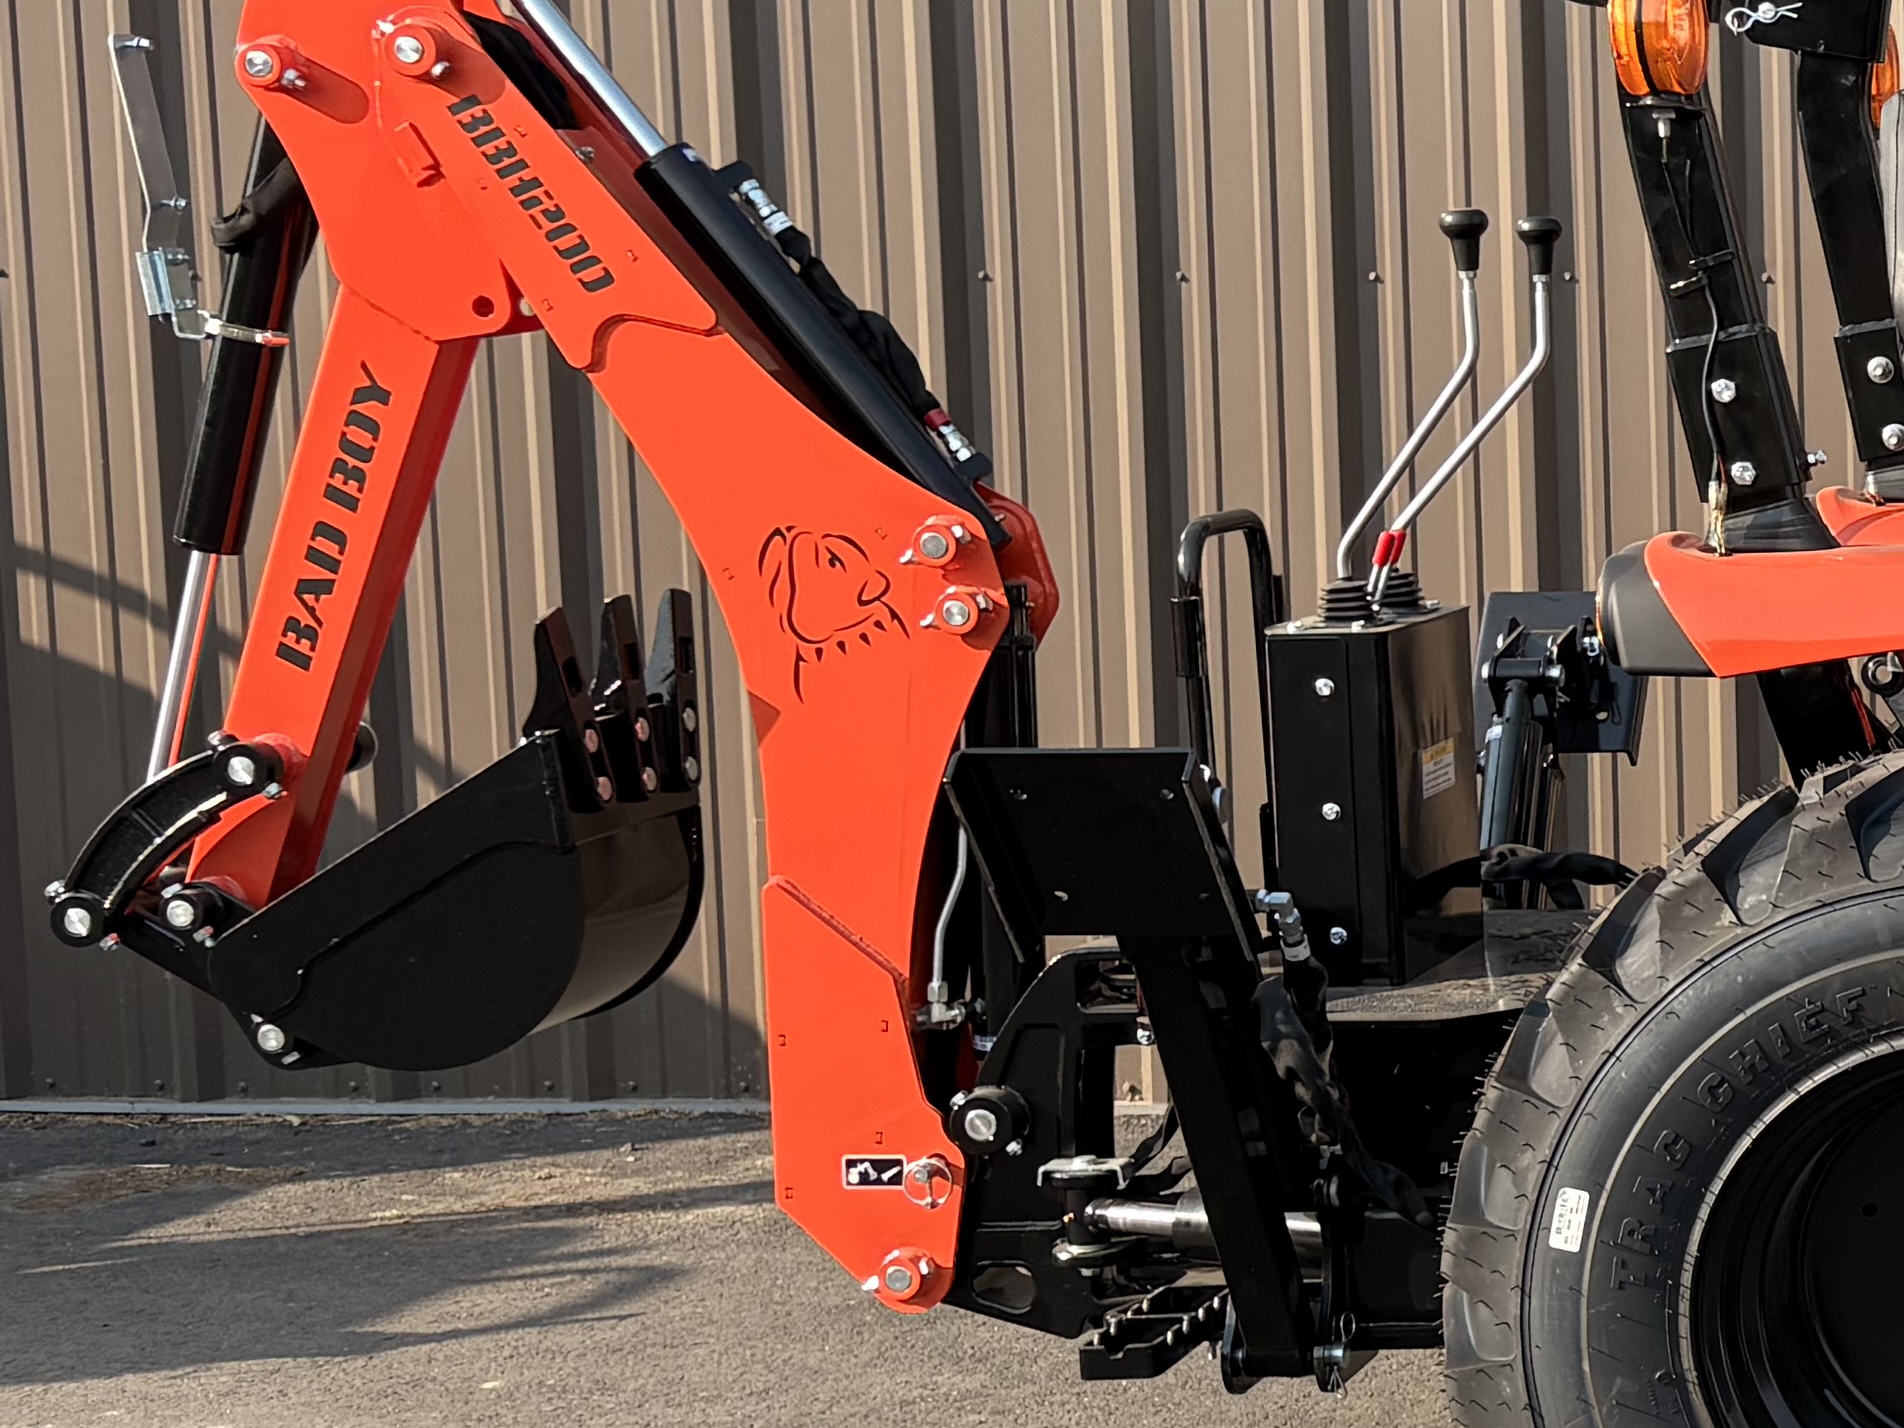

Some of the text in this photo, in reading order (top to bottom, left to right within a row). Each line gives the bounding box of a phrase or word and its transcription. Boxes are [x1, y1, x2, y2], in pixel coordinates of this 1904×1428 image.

[447, 94, 616, 294] BBH200
[275, 361, 394, 671] BAD BOY
[1612, 983, 1874, 1292] TRAC CHIEF
